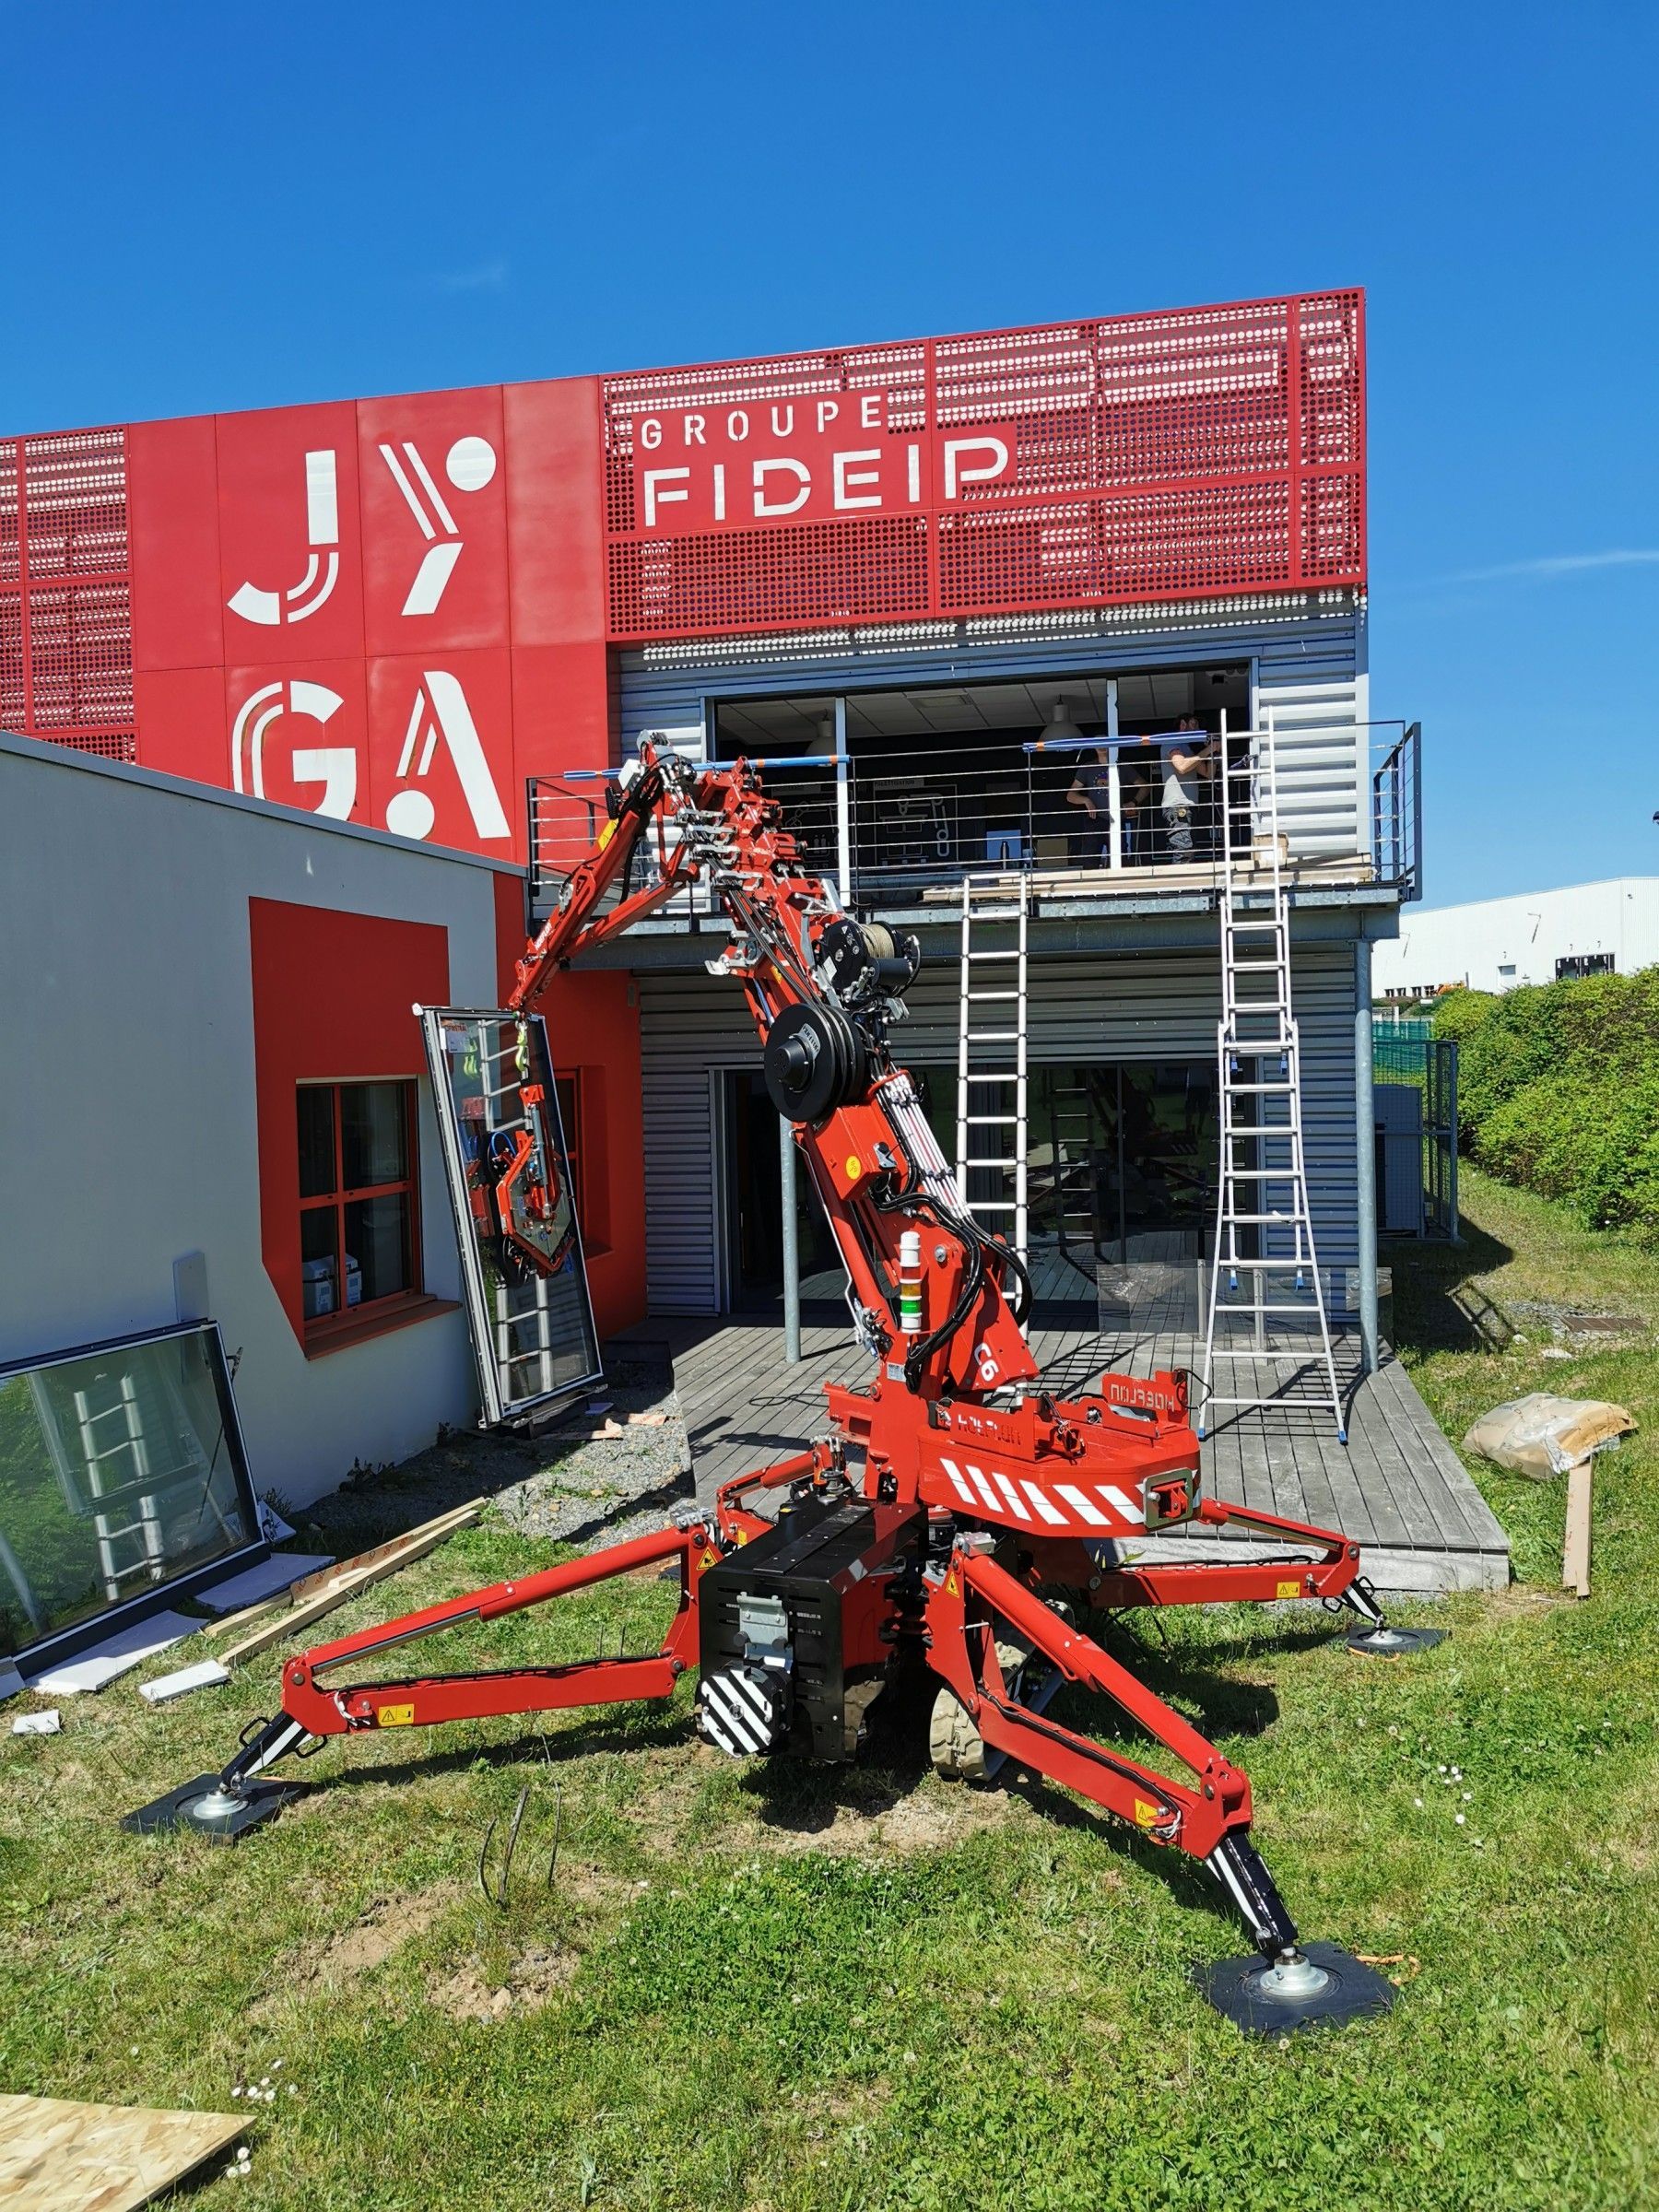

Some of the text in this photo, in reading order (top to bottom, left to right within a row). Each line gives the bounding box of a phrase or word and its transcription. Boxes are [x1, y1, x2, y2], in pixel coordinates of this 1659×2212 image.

[641, 394, 882, 450] GROUPE
[643, 436, 1009, 527] FIDEIP
[973, 1342, 1000, 1382] C6
